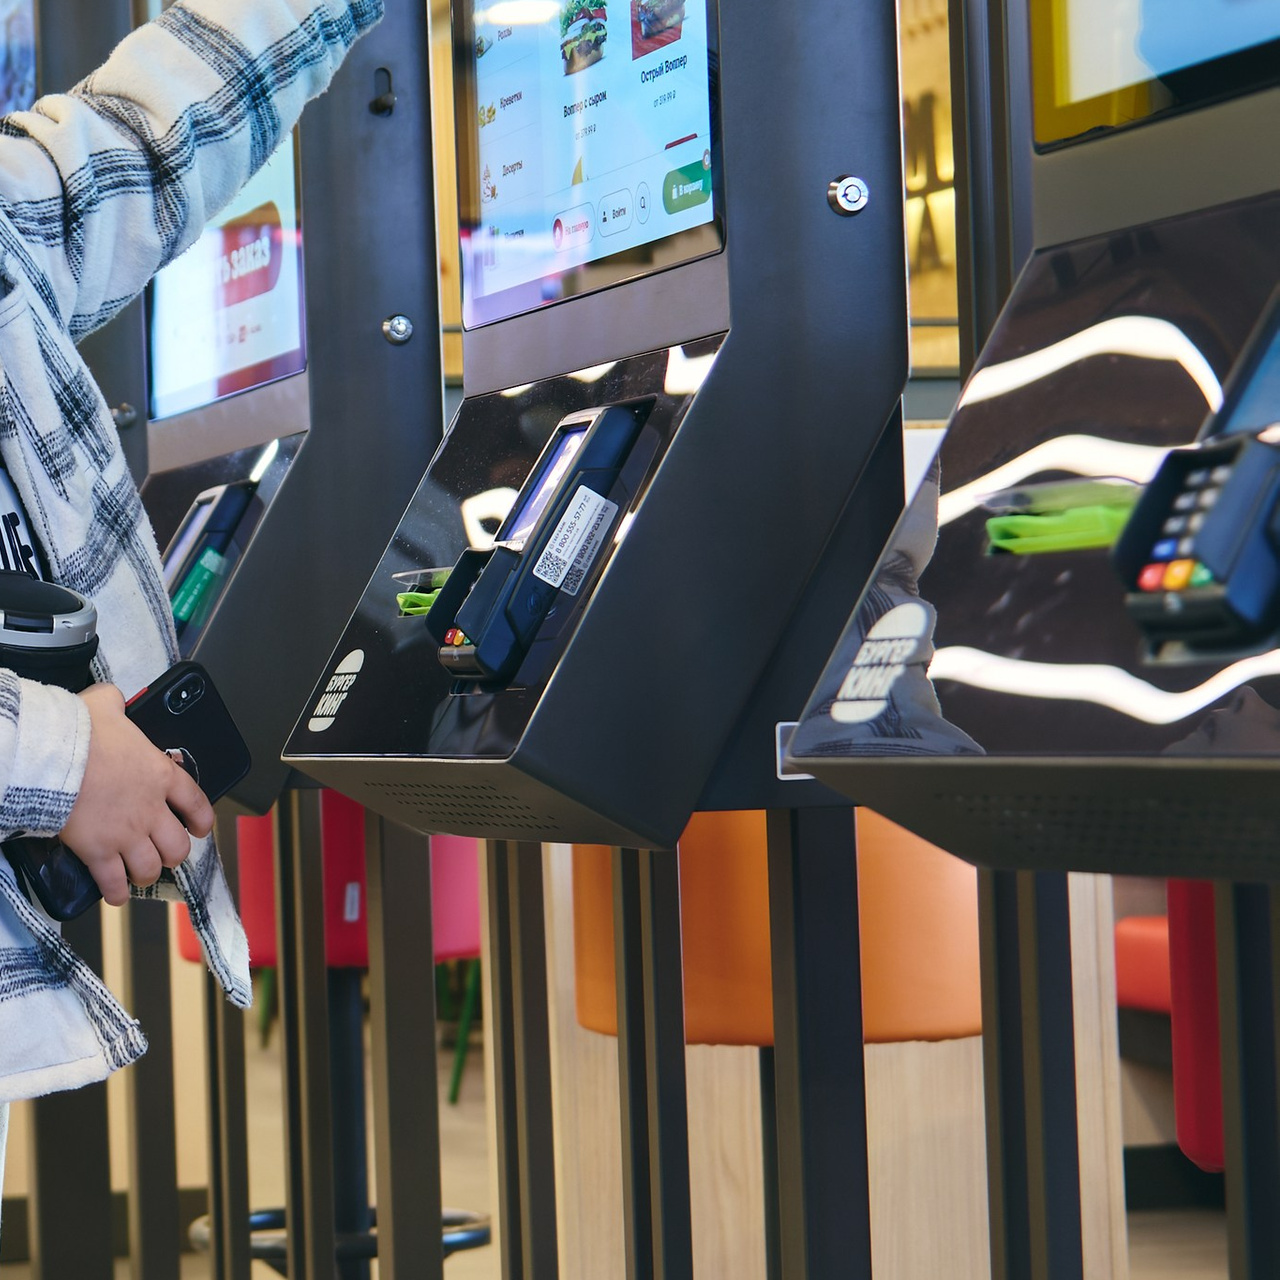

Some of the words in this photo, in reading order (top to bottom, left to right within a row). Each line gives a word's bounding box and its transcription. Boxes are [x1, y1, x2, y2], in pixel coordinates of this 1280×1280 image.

[640, 62, 664, 84] Острый
[664, 54, 688, 74] Воппер
[563, 98, 583, 119] Воппер
[588, 90, 607, 107] сыром
[559, 534, 569, 548] 800
[567, 502, 587, 535] 555-57-77
[325, 674, 357, 692] БУРГЕР
[313, 692, 348, 716] КИНГ
